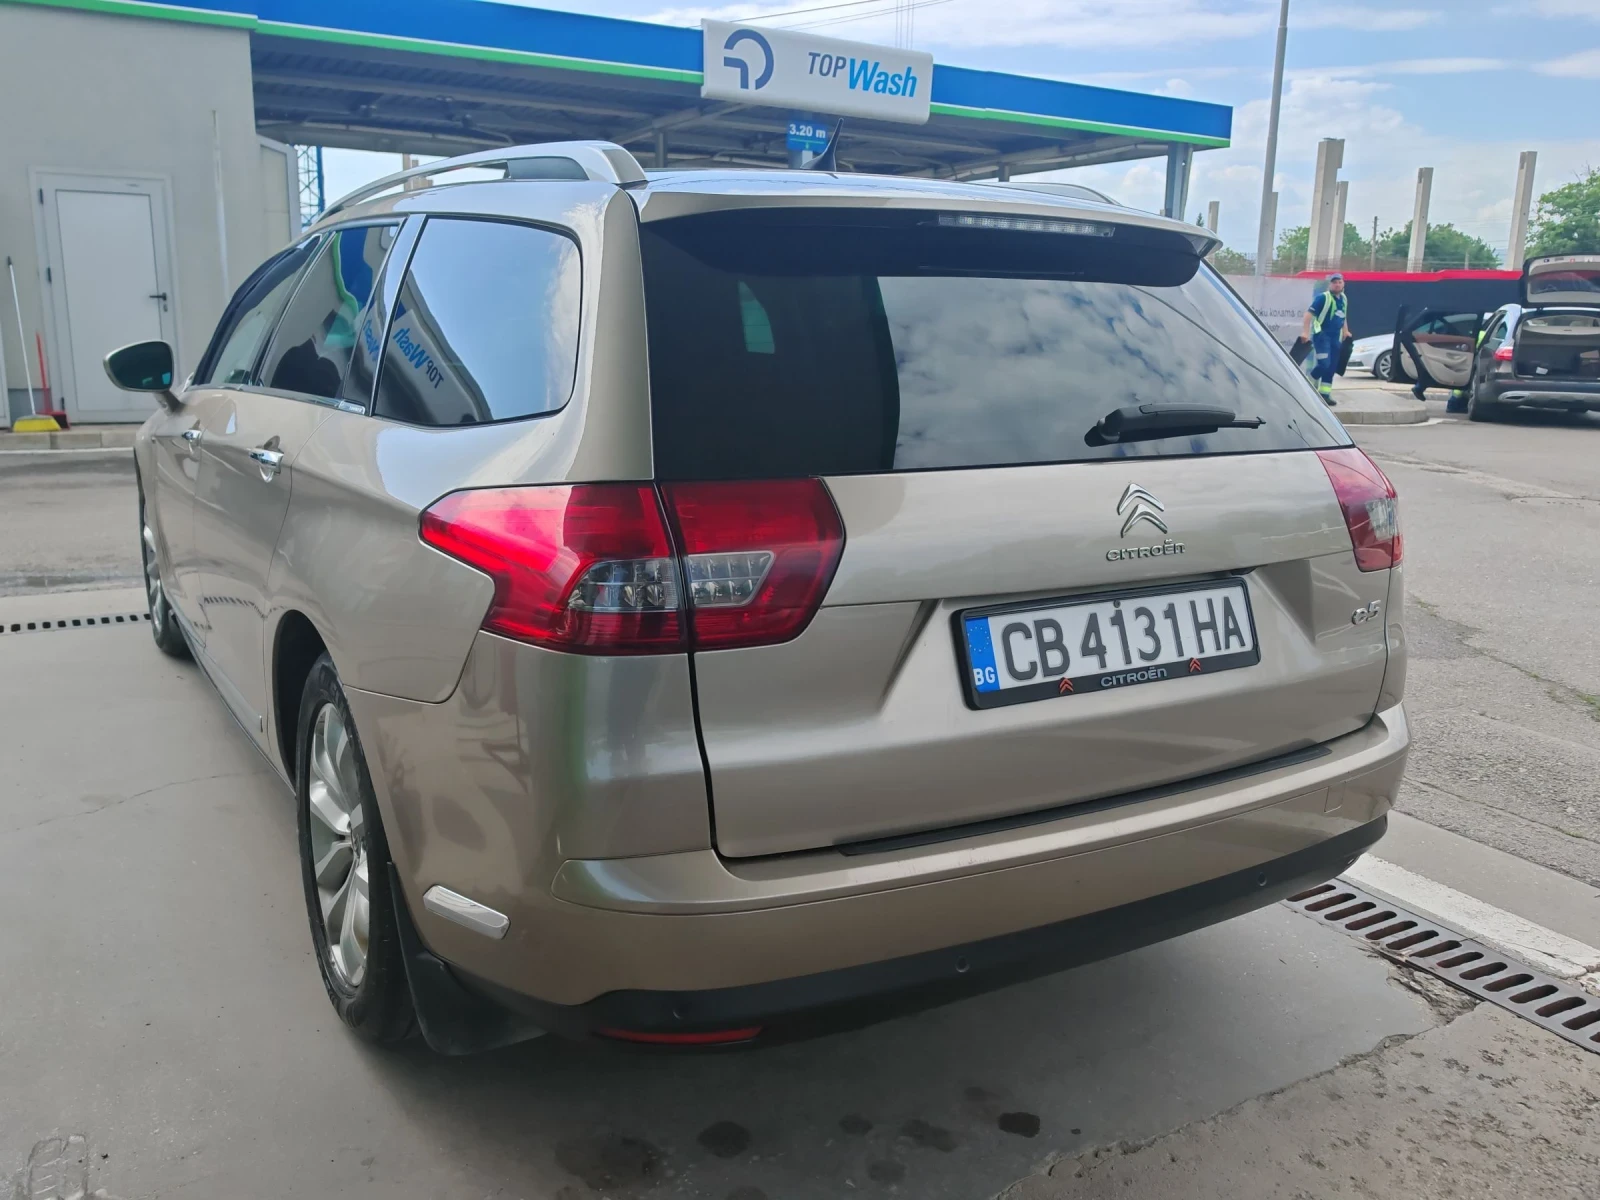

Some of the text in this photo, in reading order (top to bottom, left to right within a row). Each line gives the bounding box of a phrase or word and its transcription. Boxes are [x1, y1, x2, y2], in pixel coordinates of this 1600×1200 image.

[789, 124, 826, 138] 3.20 m
[973, 666, 996, 686] BG
